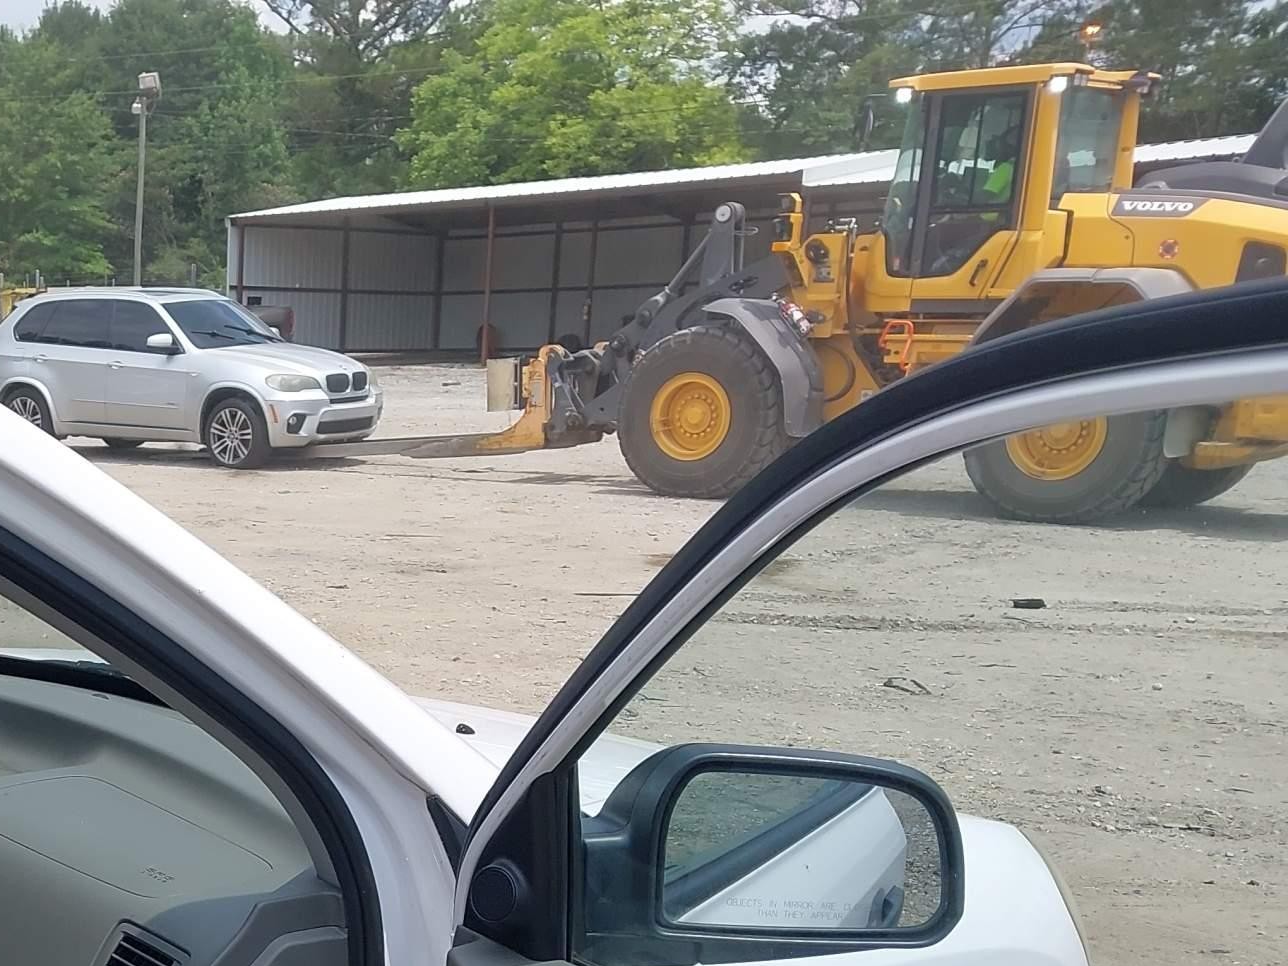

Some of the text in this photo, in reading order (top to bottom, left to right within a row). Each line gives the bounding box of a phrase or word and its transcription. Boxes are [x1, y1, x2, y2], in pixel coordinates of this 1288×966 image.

[1122, 201, 1194, 212] VOLVO
[726, 897, 762, 907] OBJECTS
[769, 899, 777, 909] IN
[783, 900, 814, 910] MIRROR
[821, 902, 837, 911] ARE
[758, 909, 844, 921] THAN THEY APPEAR
